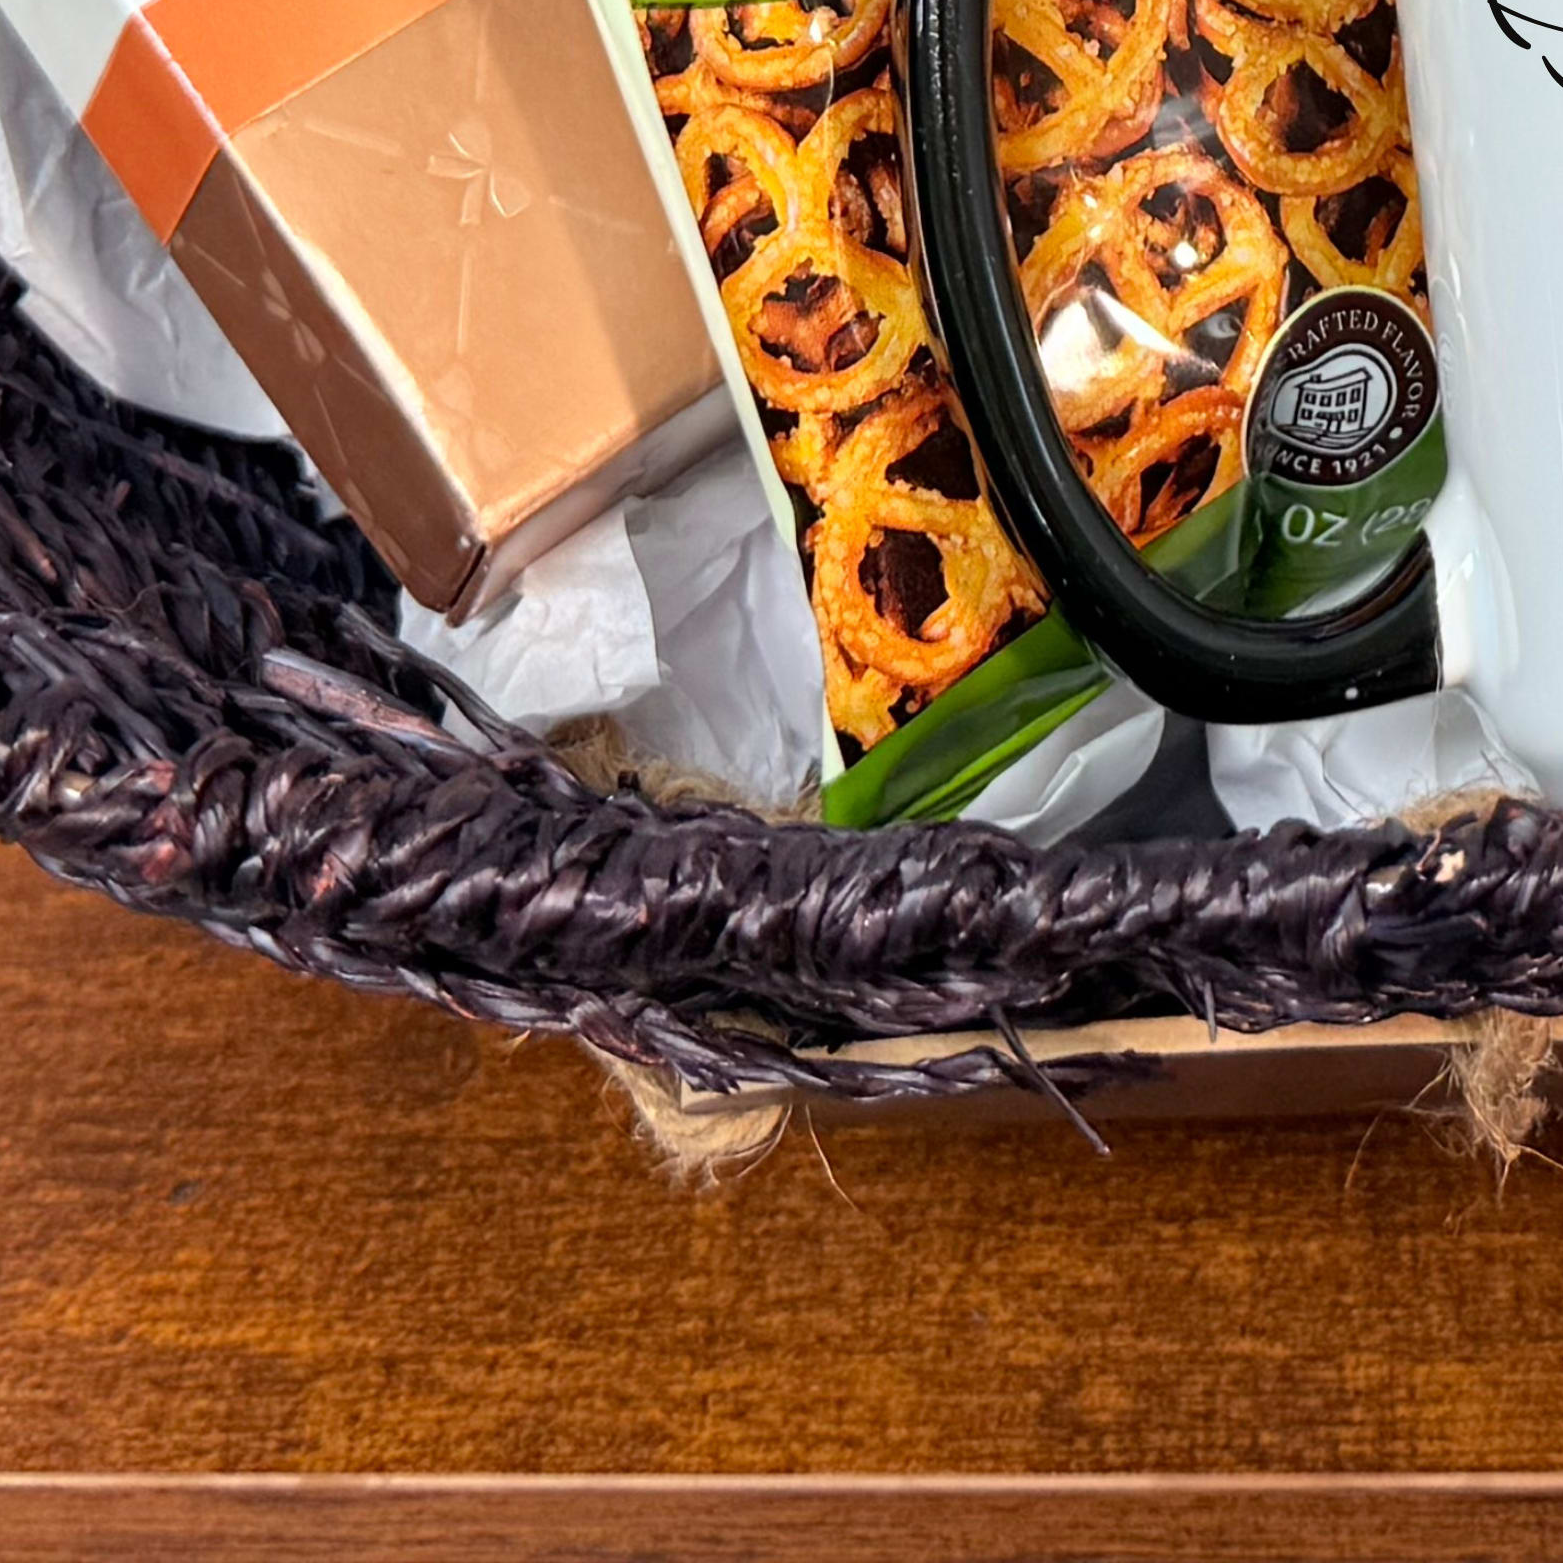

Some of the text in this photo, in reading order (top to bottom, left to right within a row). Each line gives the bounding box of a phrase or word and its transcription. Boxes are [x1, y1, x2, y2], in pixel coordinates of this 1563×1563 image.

[1284, 308, 1425, 419] RAFTED FLAVOR
[1264, 440, 1386, 475] NCE 1921
[1282, 504, 1349, 547] OZ
